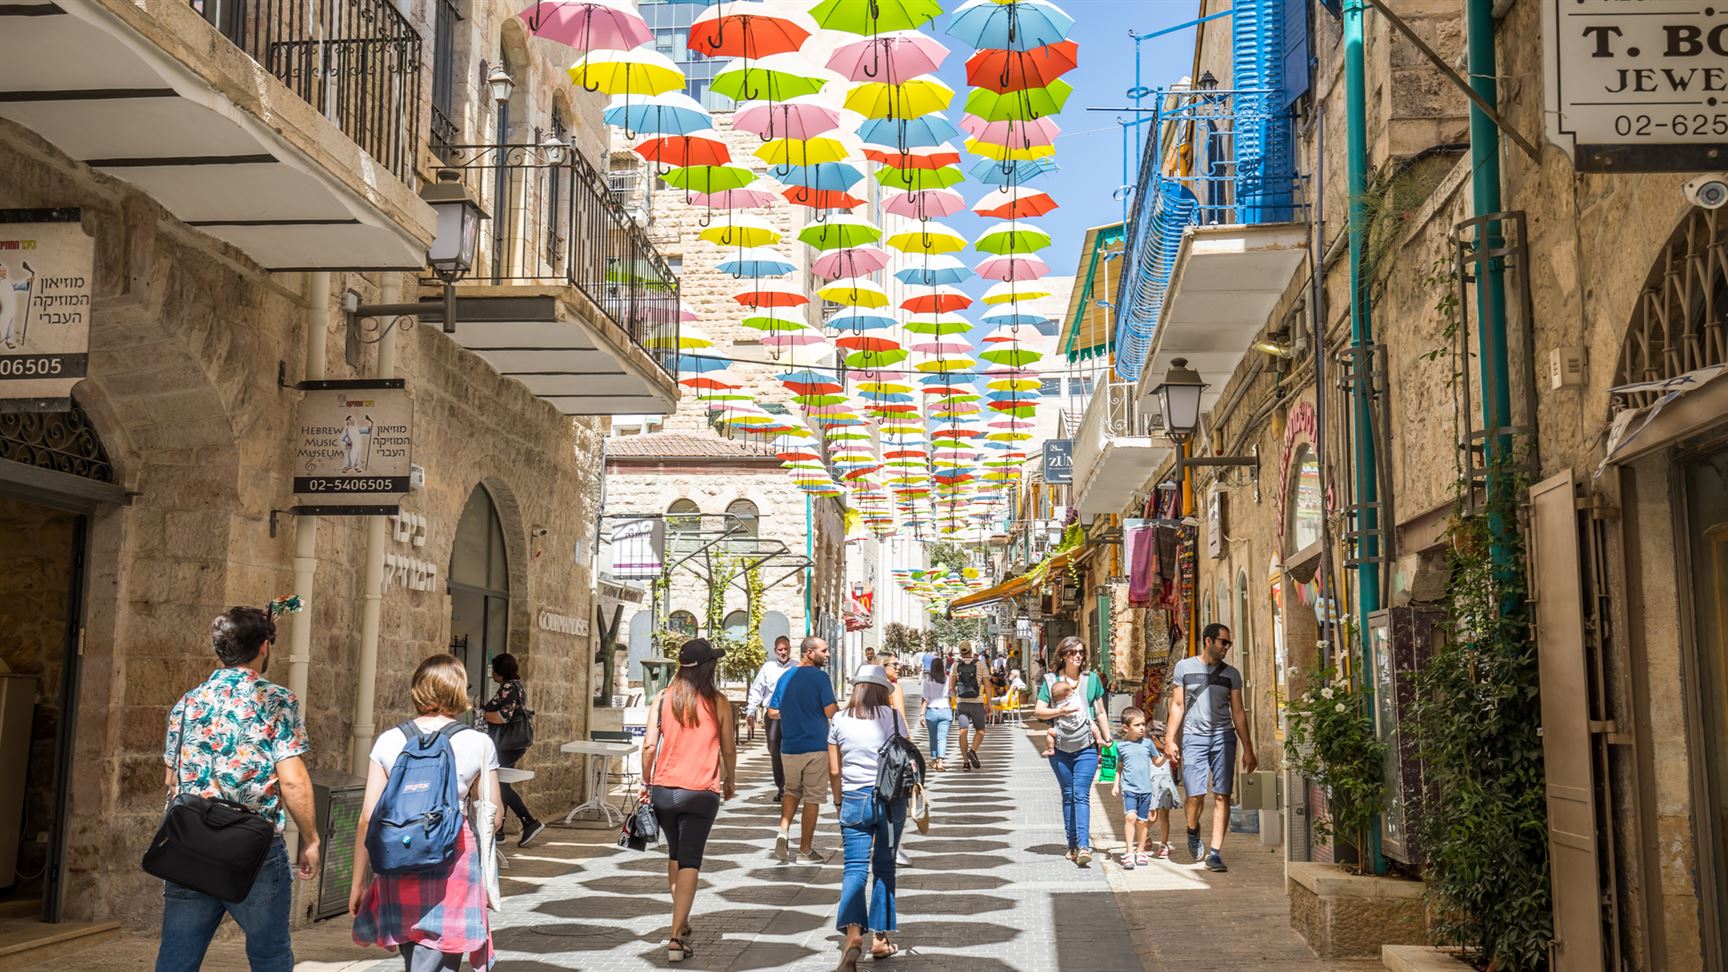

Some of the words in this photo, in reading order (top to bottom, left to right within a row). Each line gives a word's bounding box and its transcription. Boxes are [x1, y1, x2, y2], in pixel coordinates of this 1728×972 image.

[1582, 26, 1640, 58] T.
[1605, 67, 1728, 93] JEWE
[1615, 114, 1728, 136] 02-625
[40, 276, 85, 294] מוזיאון
[33, 294, 90, 311] המוזיקה
[39, 312, 82, 325] העברי
[301, 426, 344, 435] HEBREW
[377, 425, 407, 437] מוזיאון
[304, 439, 338, 447] MUSIC
[372, 437, 411, 448] המוזיקה
[297, 449, 345, 458] MUSEUM
[376, 448, 406, 457] העברי
[309, 479, 393, 491] 02-5406505
